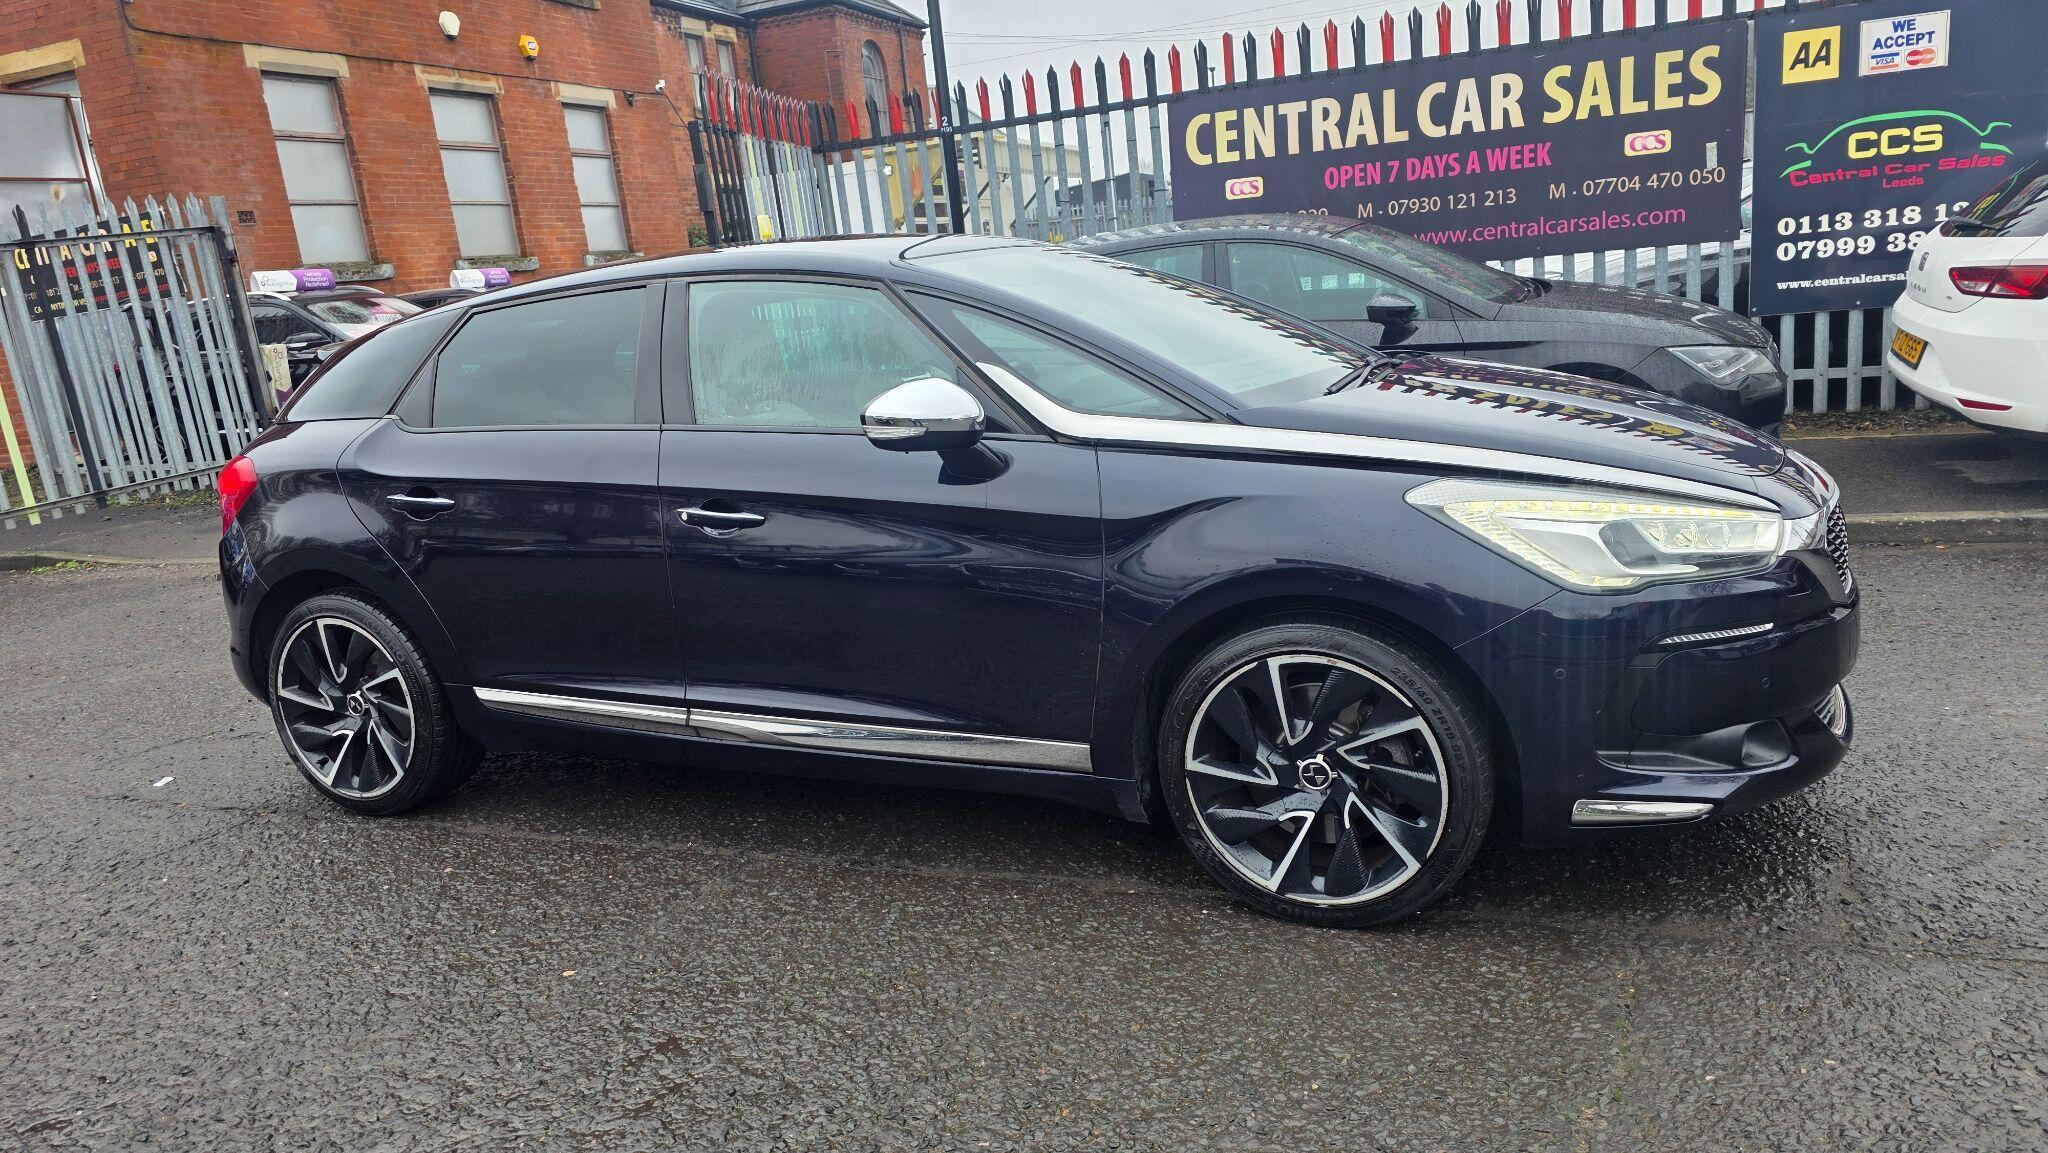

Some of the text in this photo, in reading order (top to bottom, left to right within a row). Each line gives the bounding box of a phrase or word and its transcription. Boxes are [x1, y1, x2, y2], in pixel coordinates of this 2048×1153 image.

[1872, 30, 1936, 50] ACCEPT
[1892, 18, 1917, 33] WE
[1789, 38, 1832, 71] AA
[1875, 57, 1895, 66] VISA
[1906, 51, 1936, 62] MasterCard
[1185, 44, 1723, 166] CENTRAL CAR SALES
[941, 116, 949, 126] 2
[1629, 133, 1666, 152] CCS
[1848, 123, 1944, 159] CCS
[1324, 142, 1552, 190] OPEN 7 DAYS A WEEK
[1789, 153, 2006, 187] Central Car Sales
[1229, 179, 1261, 197] CCS
[1549, 182, 1566, 200] M
[1582, 175, 1641, 196] 07704
[1646, 171, 1683, 190] 470
[1689, 166, 1726, 186] 050
[1882, 175, 1925, 189] Leeds
[1357, 202, 1373, 219] M
[1388, 196, 1441, 216] 07930
[1447, 193, 1476, 210] 121
[1484, 188, 1517, 207] 213
[1413, 207, 1687, 245] www.centralcarsales.com
[1777, 211, 1853, 235] 0113
[1863, 205, 1922, 228] 318
[1776, 234, 1876, 262] 07999
